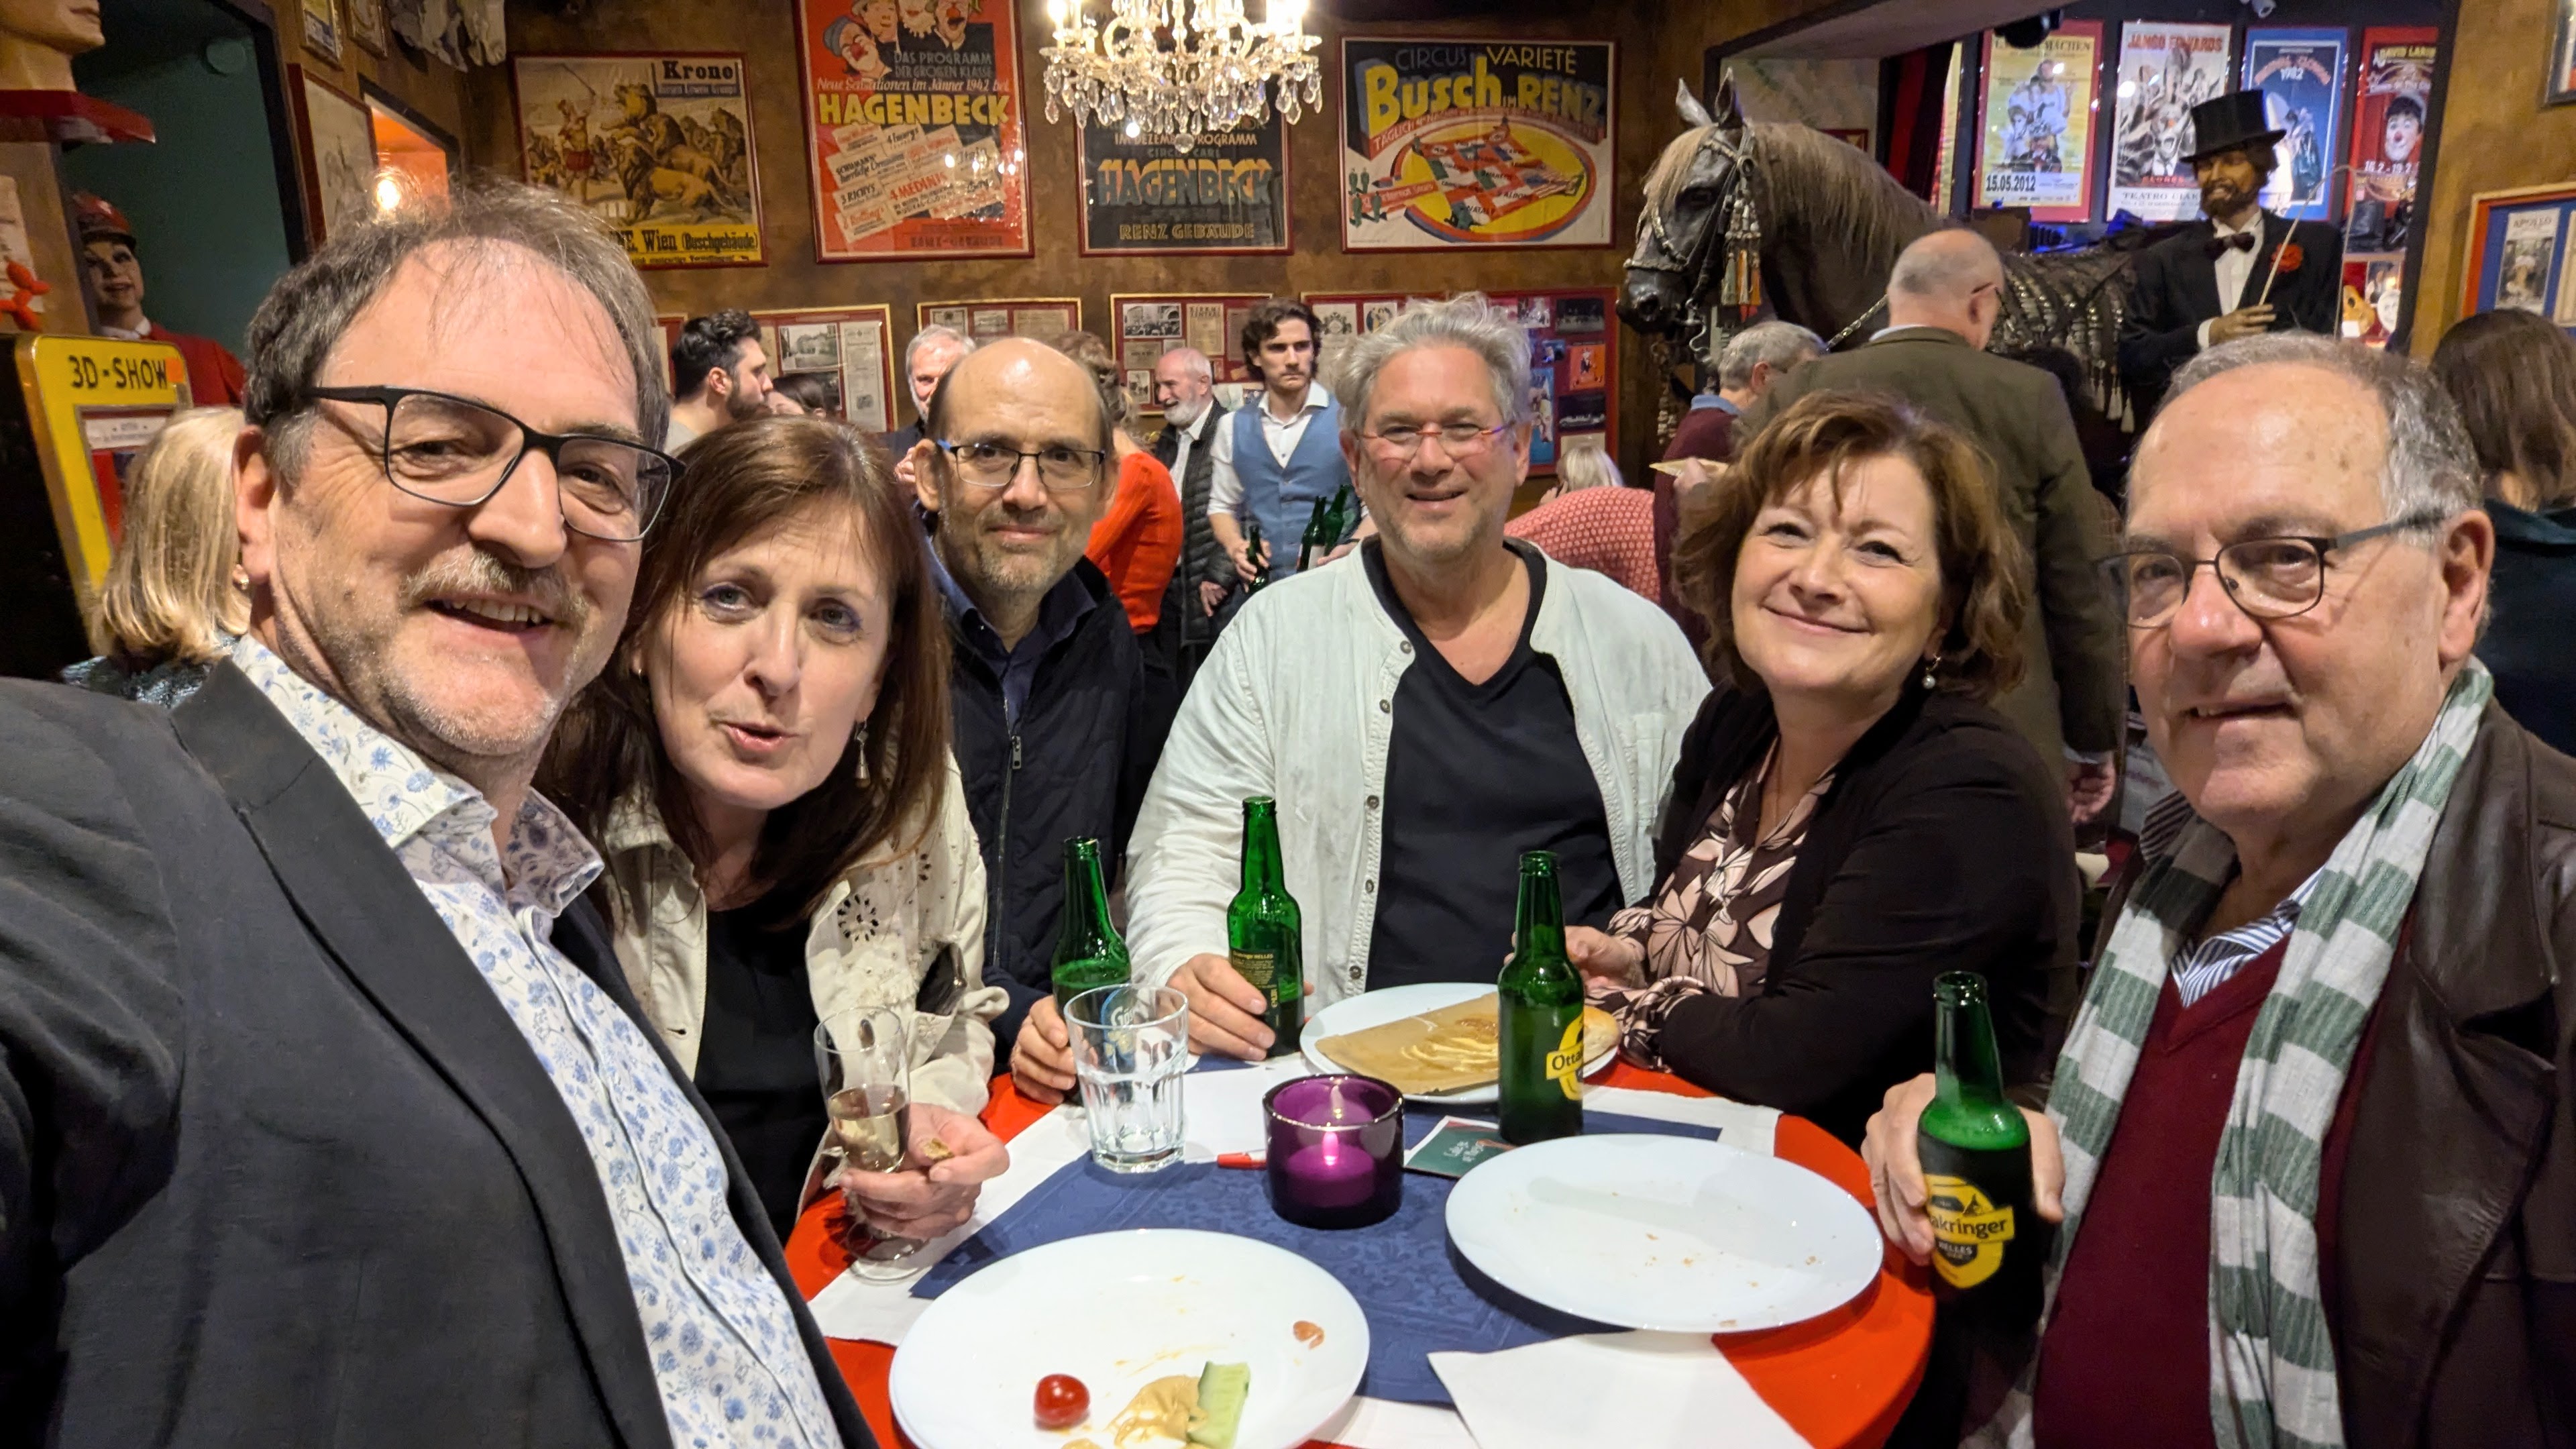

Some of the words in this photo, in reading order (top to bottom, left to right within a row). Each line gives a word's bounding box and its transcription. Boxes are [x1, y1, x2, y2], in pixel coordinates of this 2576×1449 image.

[894, 52, 916, 64] DAS
[919, 52, 992, 65] PROGRAMM
[1395, 47, 1466, 70] CIRCUS
[1364, 55, 1502, 138] Busch
[1517, 74, 1604, 127] RENZ
[818, 93, 1010, 125] HAGENBECK
[1114, 133, 1129, 146] IM
[1097, 159, 1273, 206] HAGENBECK
[1986, 175, 2036, 192] 15.05.2012
[641, 229, 678, 252] Wien
[1119, 223, 1168, 240] RENZ
